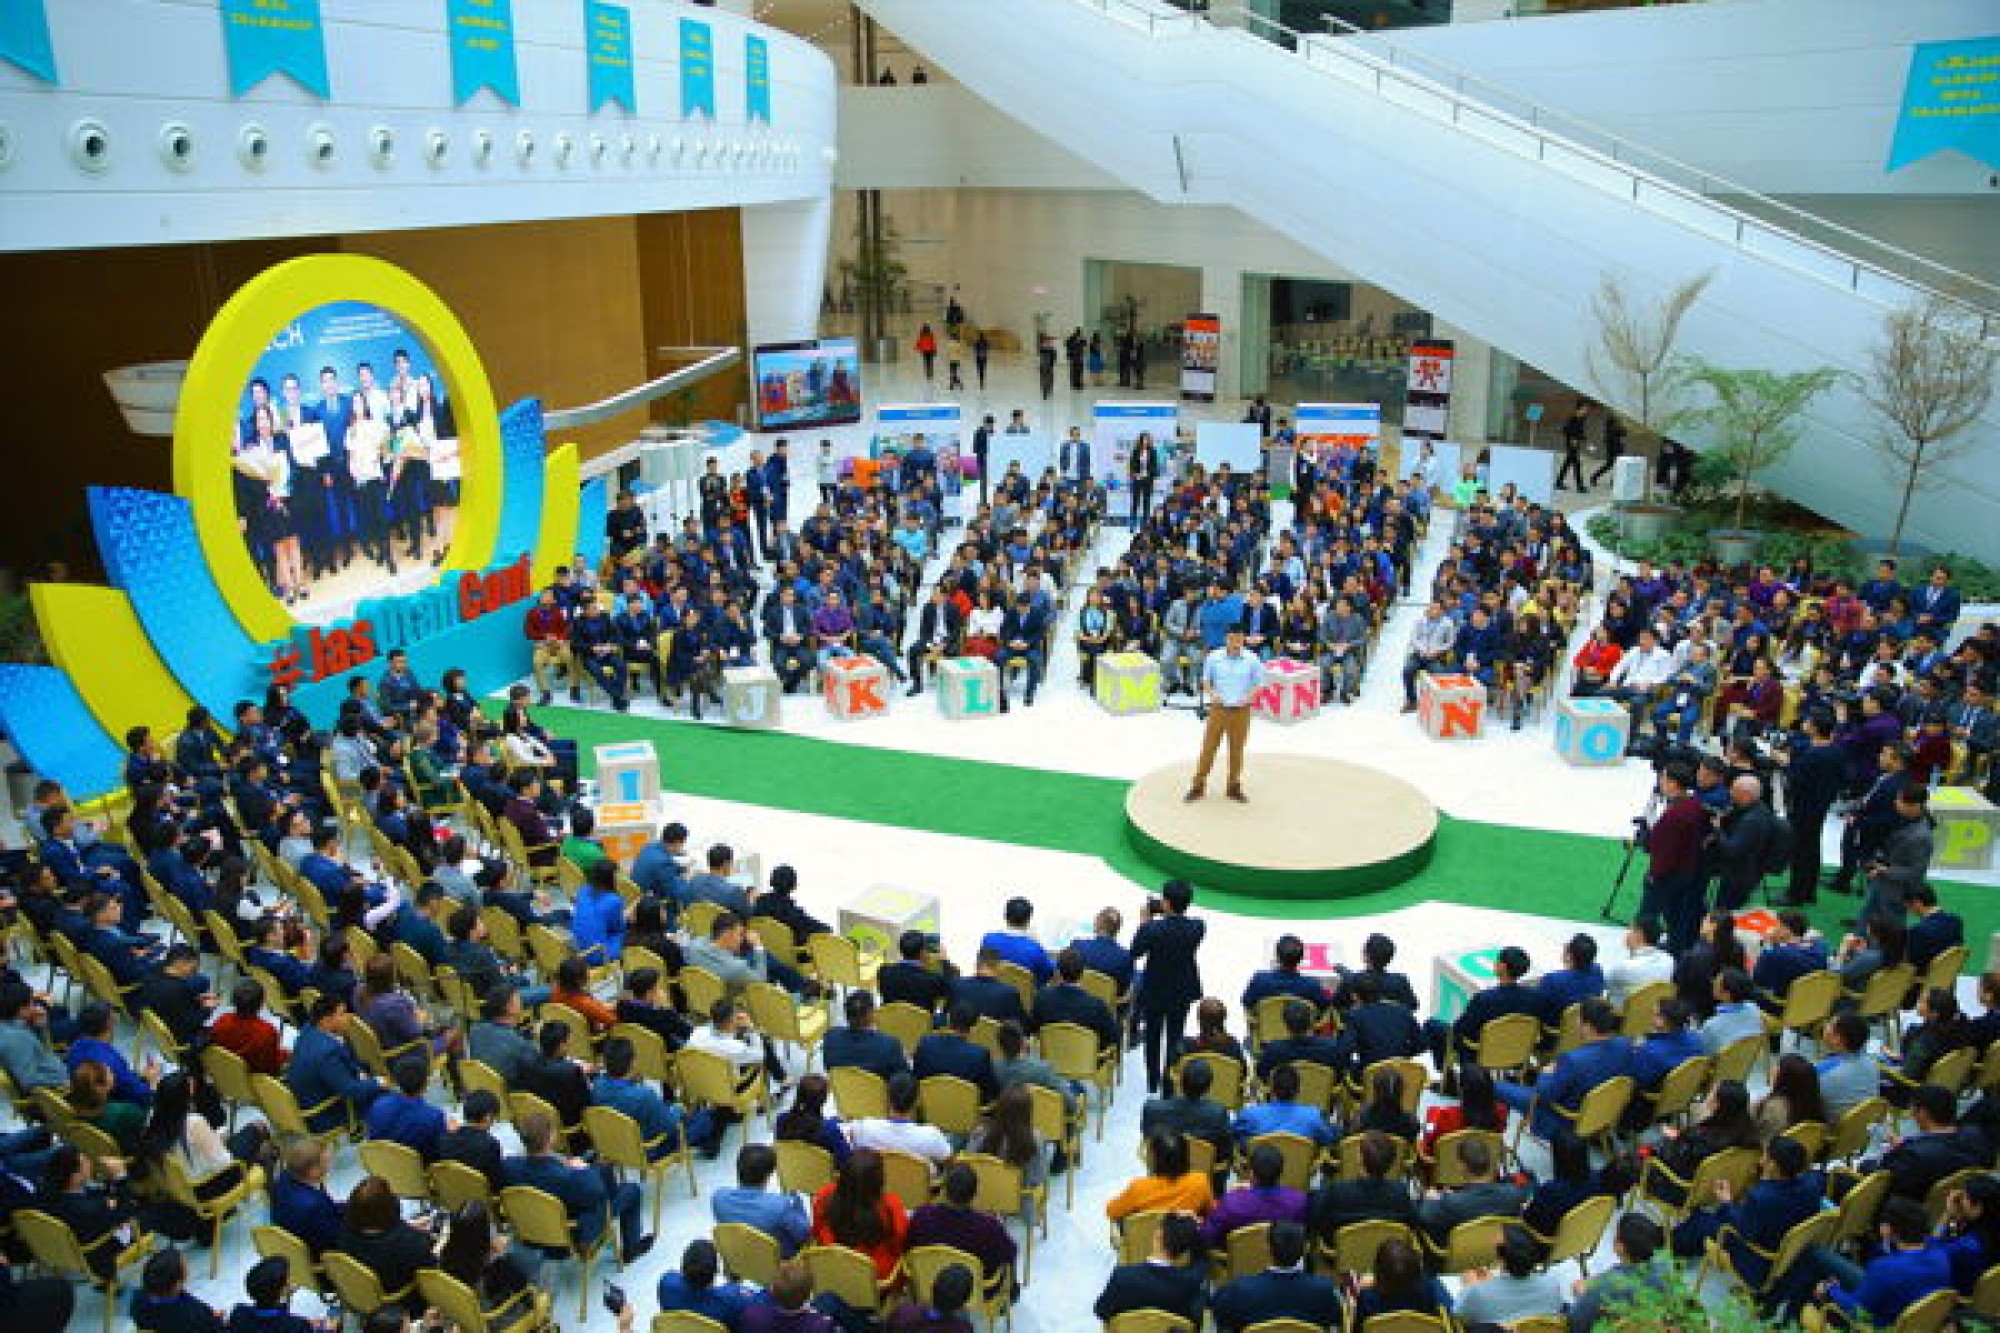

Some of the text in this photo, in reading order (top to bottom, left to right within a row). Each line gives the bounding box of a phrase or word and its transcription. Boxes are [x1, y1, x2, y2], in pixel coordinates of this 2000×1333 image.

[847, 677, 886, 714] K
[962, 678, 993, 713] L
[1119, 674, 1159, 712] M
[1581, 722, 1621, 761] O
[1940, 819, 1991, 863] P
